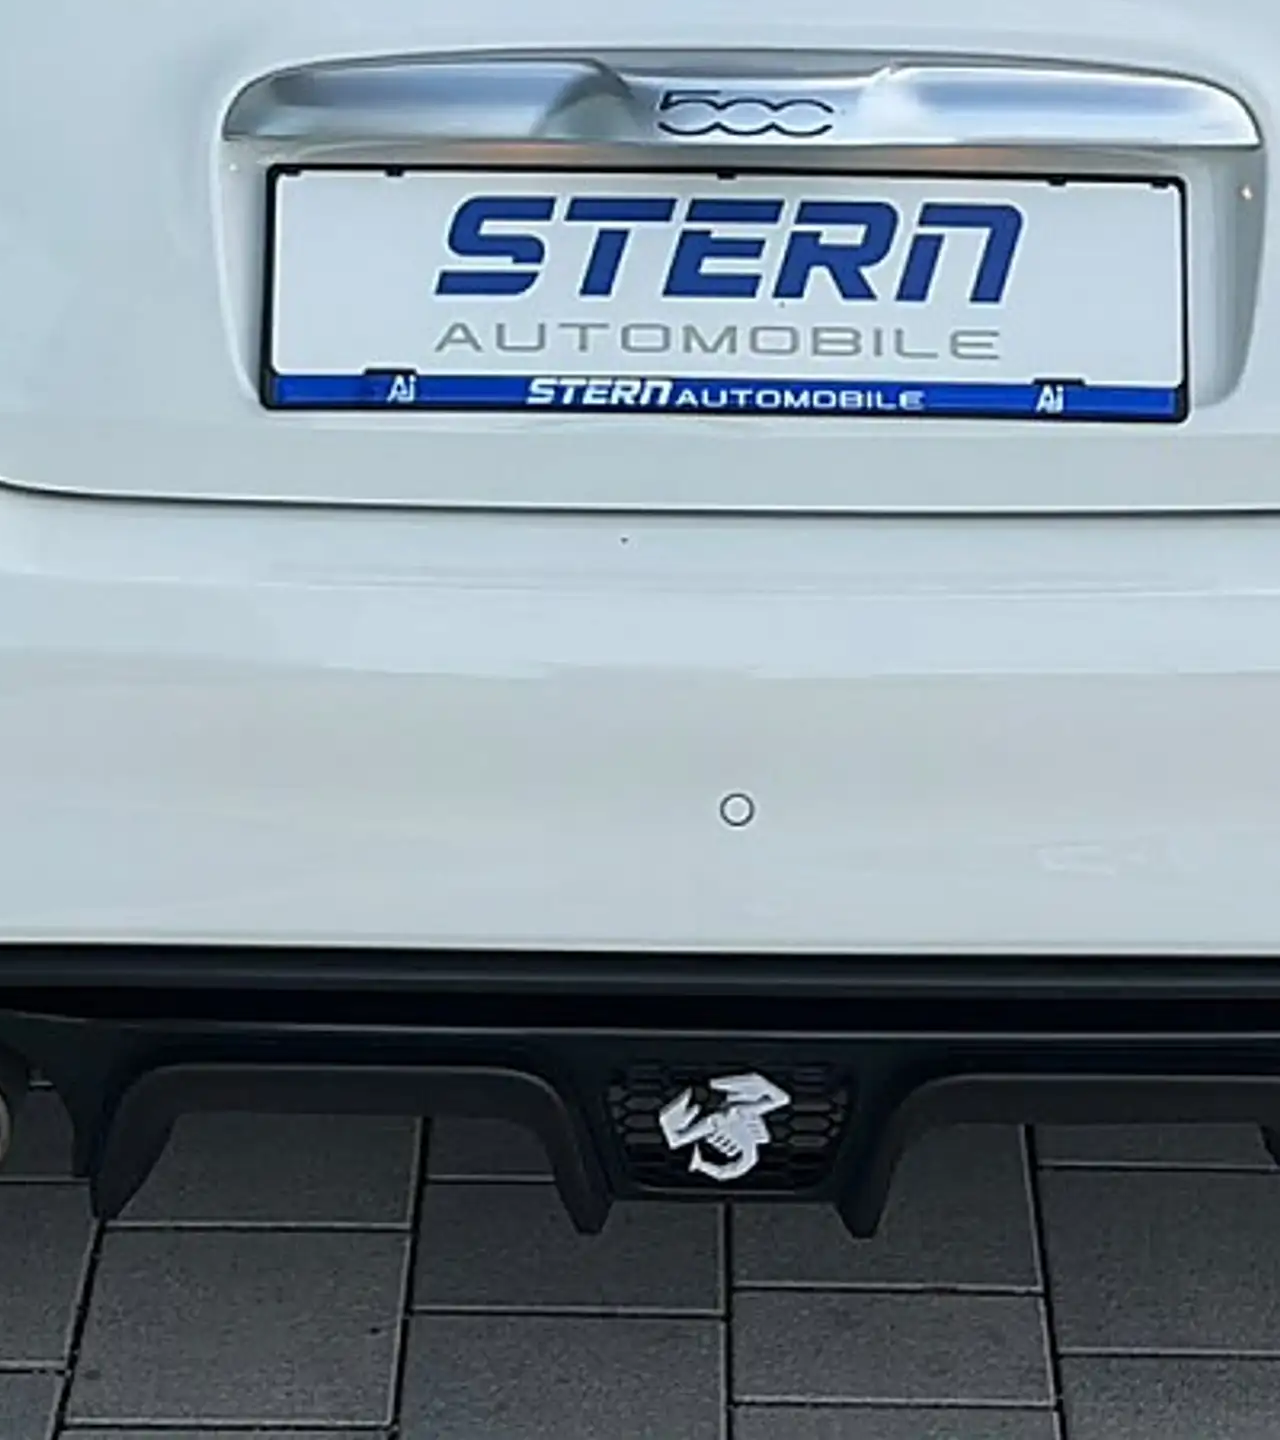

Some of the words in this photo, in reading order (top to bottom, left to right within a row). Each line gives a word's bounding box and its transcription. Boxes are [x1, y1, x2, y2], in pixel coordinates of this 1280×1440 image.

[657, 89, 835, 137] 500
[435, 195, 1024, 303] STERN
[435, 321, 1002, 360] AUTOMOBILE
[525, 376, 674, 406] STERN
[675, 388, 927, 412] AUTOMOBILE
